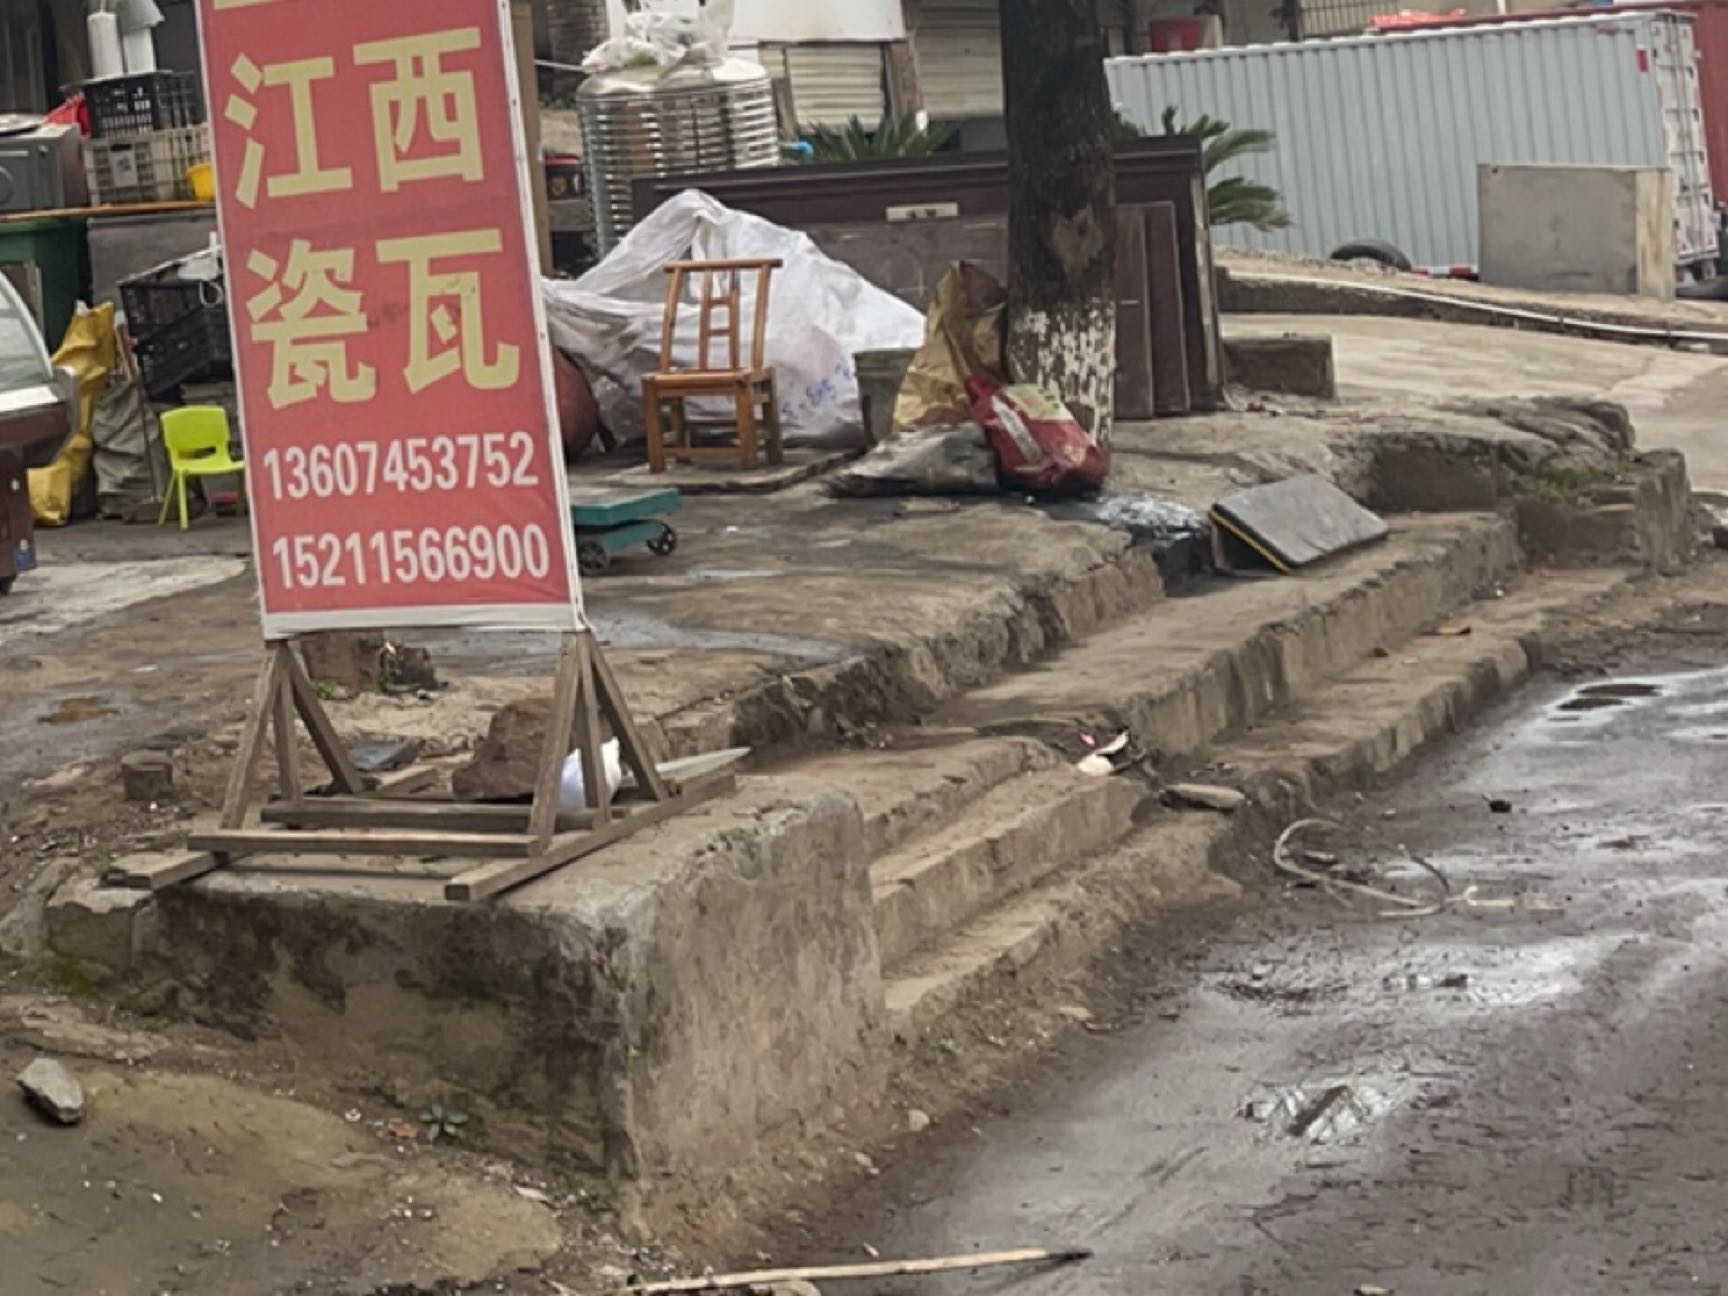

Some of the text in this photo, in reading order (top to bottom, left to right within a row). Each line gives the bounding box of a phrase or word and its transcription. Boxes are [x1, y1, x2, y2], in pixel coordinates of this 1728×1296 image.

[225, 27, 485, 210] 江西
[245, 227, 521, 411] 瓷瓦
[263, 431, 540, 501] 13607453752
[273, 522, 551, 590] 15211566900
